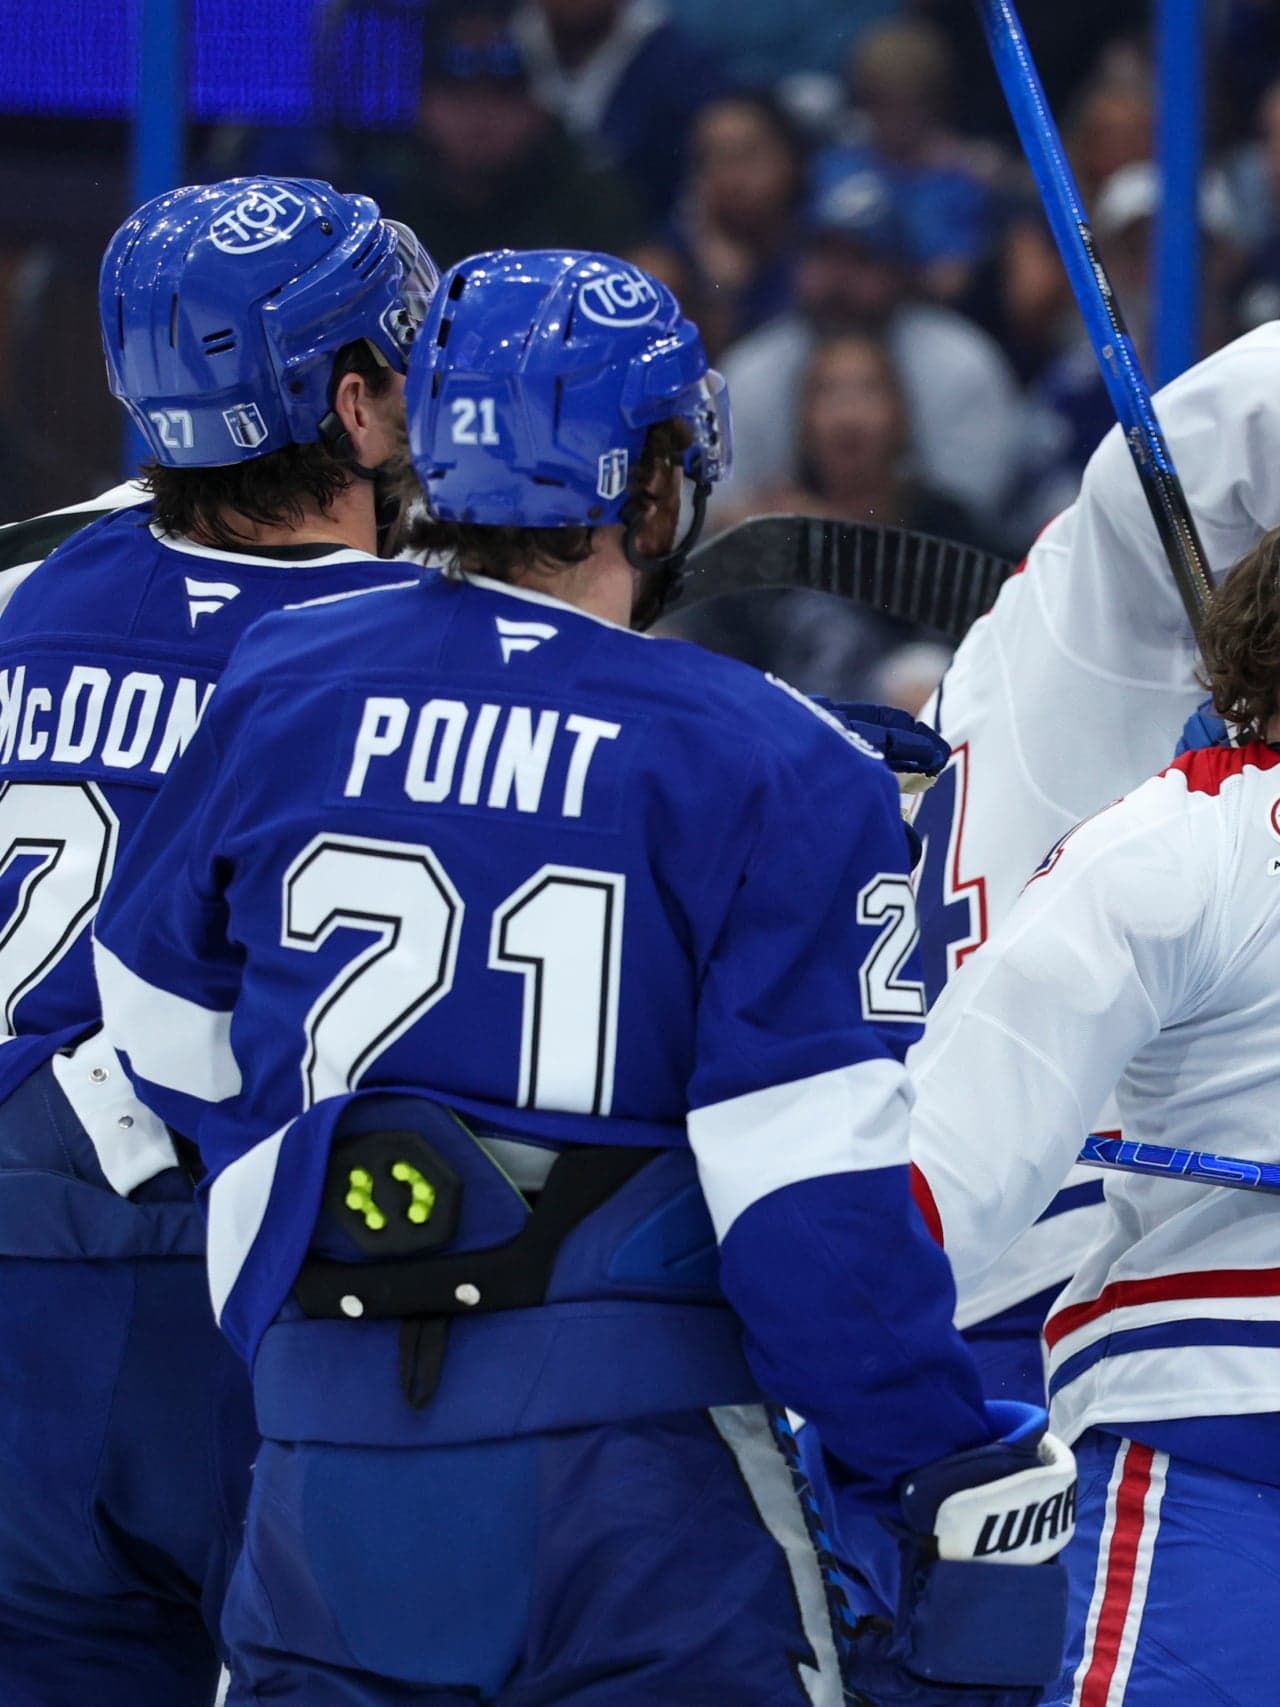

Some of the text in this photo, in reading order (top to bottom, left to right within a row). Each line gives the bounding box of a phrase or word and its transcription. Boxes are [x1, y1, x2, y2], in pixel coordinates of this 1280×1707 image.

[214, 185, 303, 242] TGH
[582, 267, 658, 315] TGH
[149, 409, 194, 449] 27
[451, 397, 500, 446] 21
[344, 697, 622, 818] POINT
[280, 831, 626, 1117] 21
[856, 871, 927, 1024] 2
